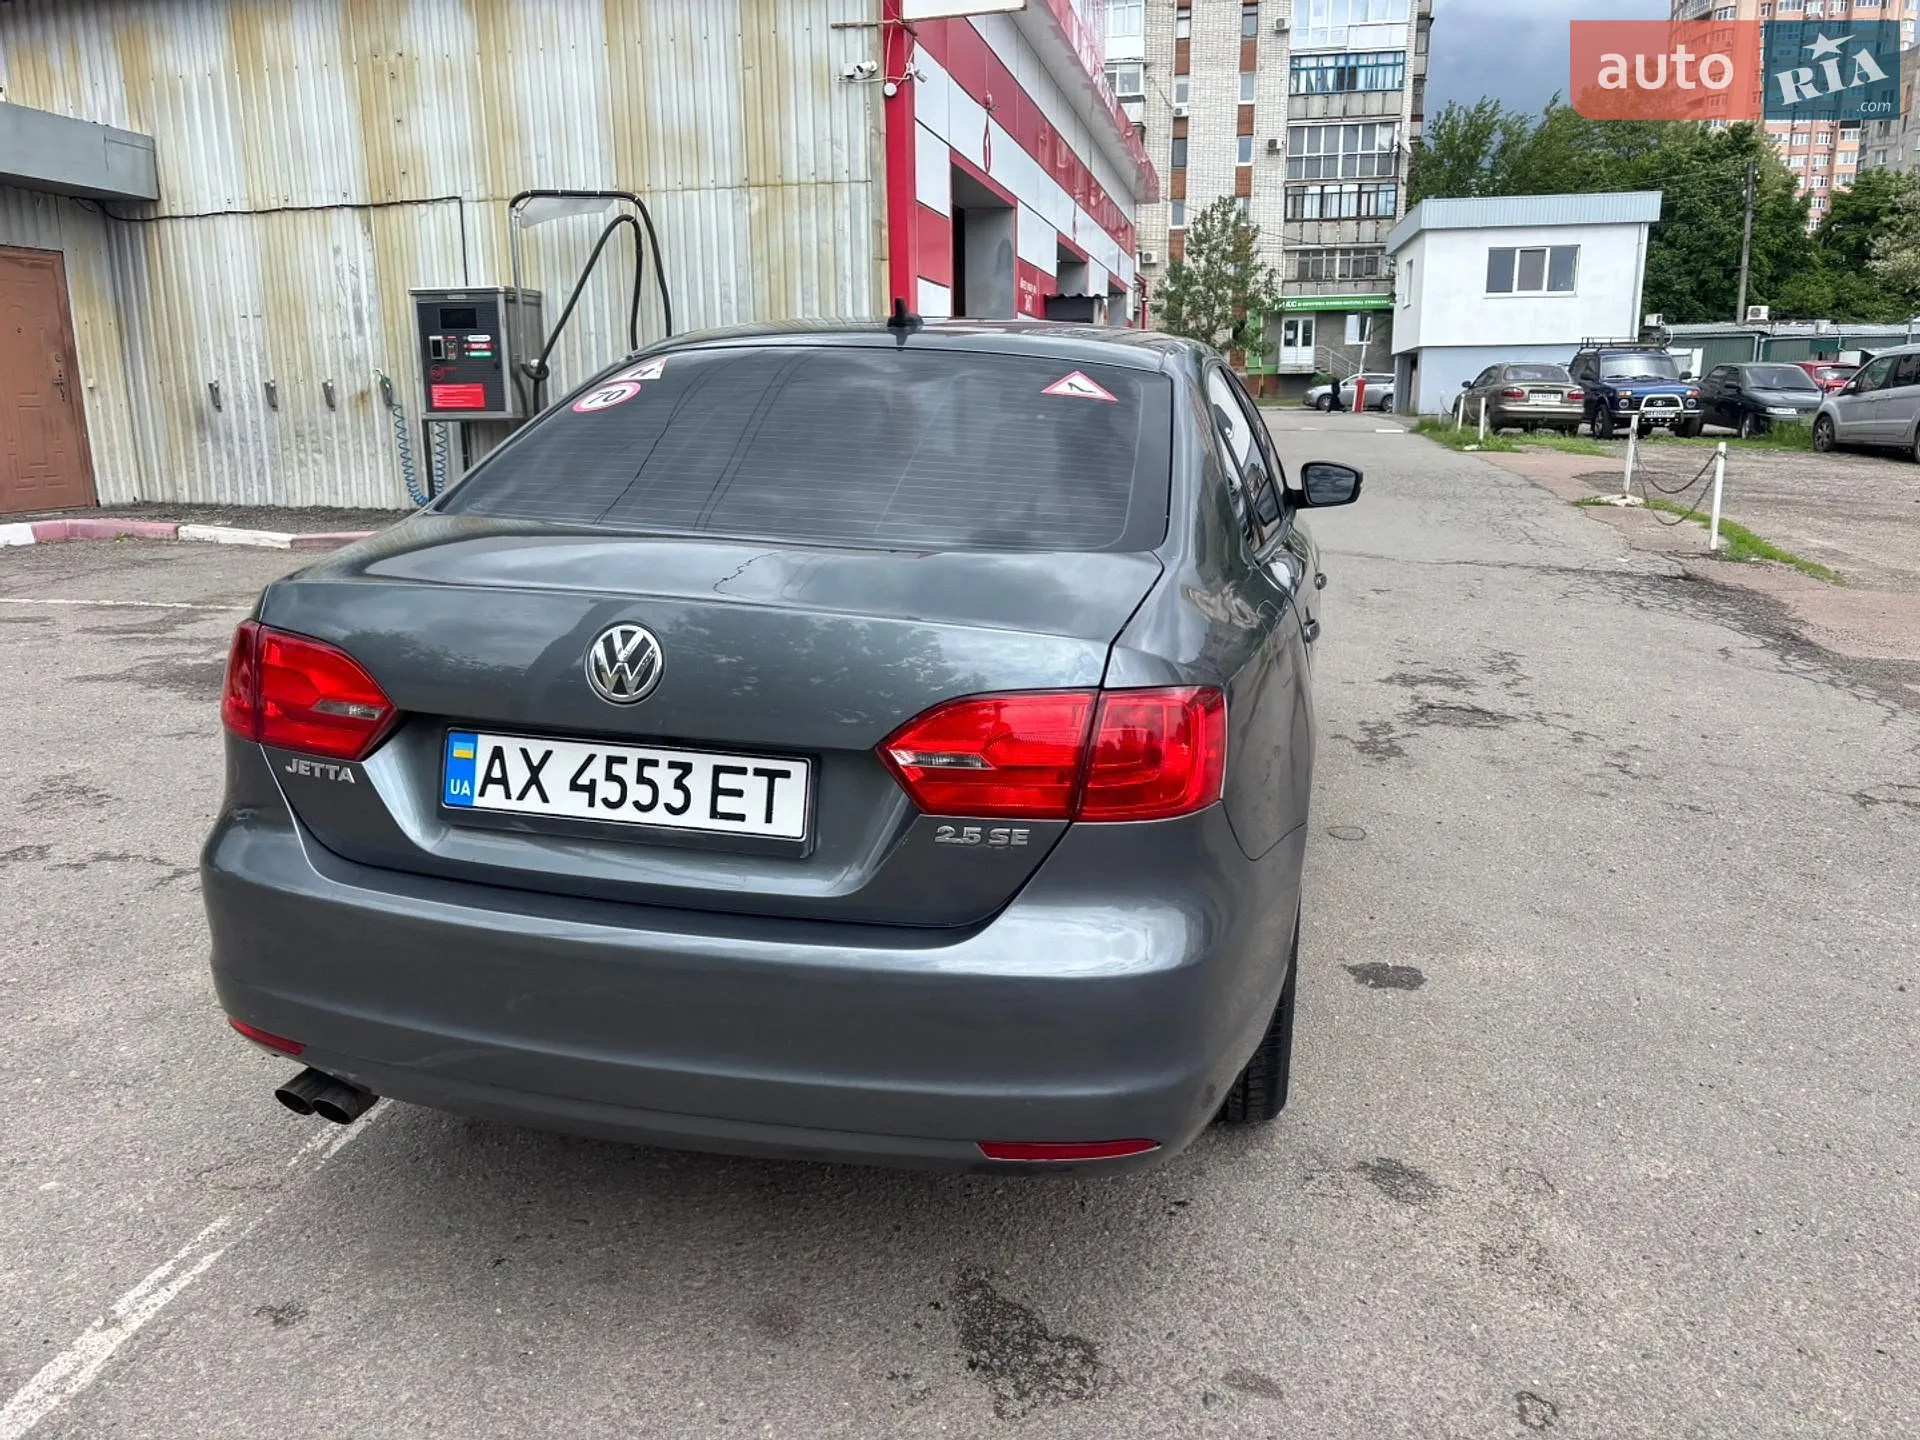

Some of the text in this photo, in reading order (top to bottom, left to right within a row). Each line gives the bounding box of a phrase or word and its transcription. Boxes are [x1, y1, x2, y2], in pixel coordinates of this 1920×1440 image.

[285, 758, 356, 784] JETTA
[450, 778, 471, 796] UA
[478, 745, 792, 824] AX 4553 ET
[934, 825, 1031, 846] 2.5 SE
